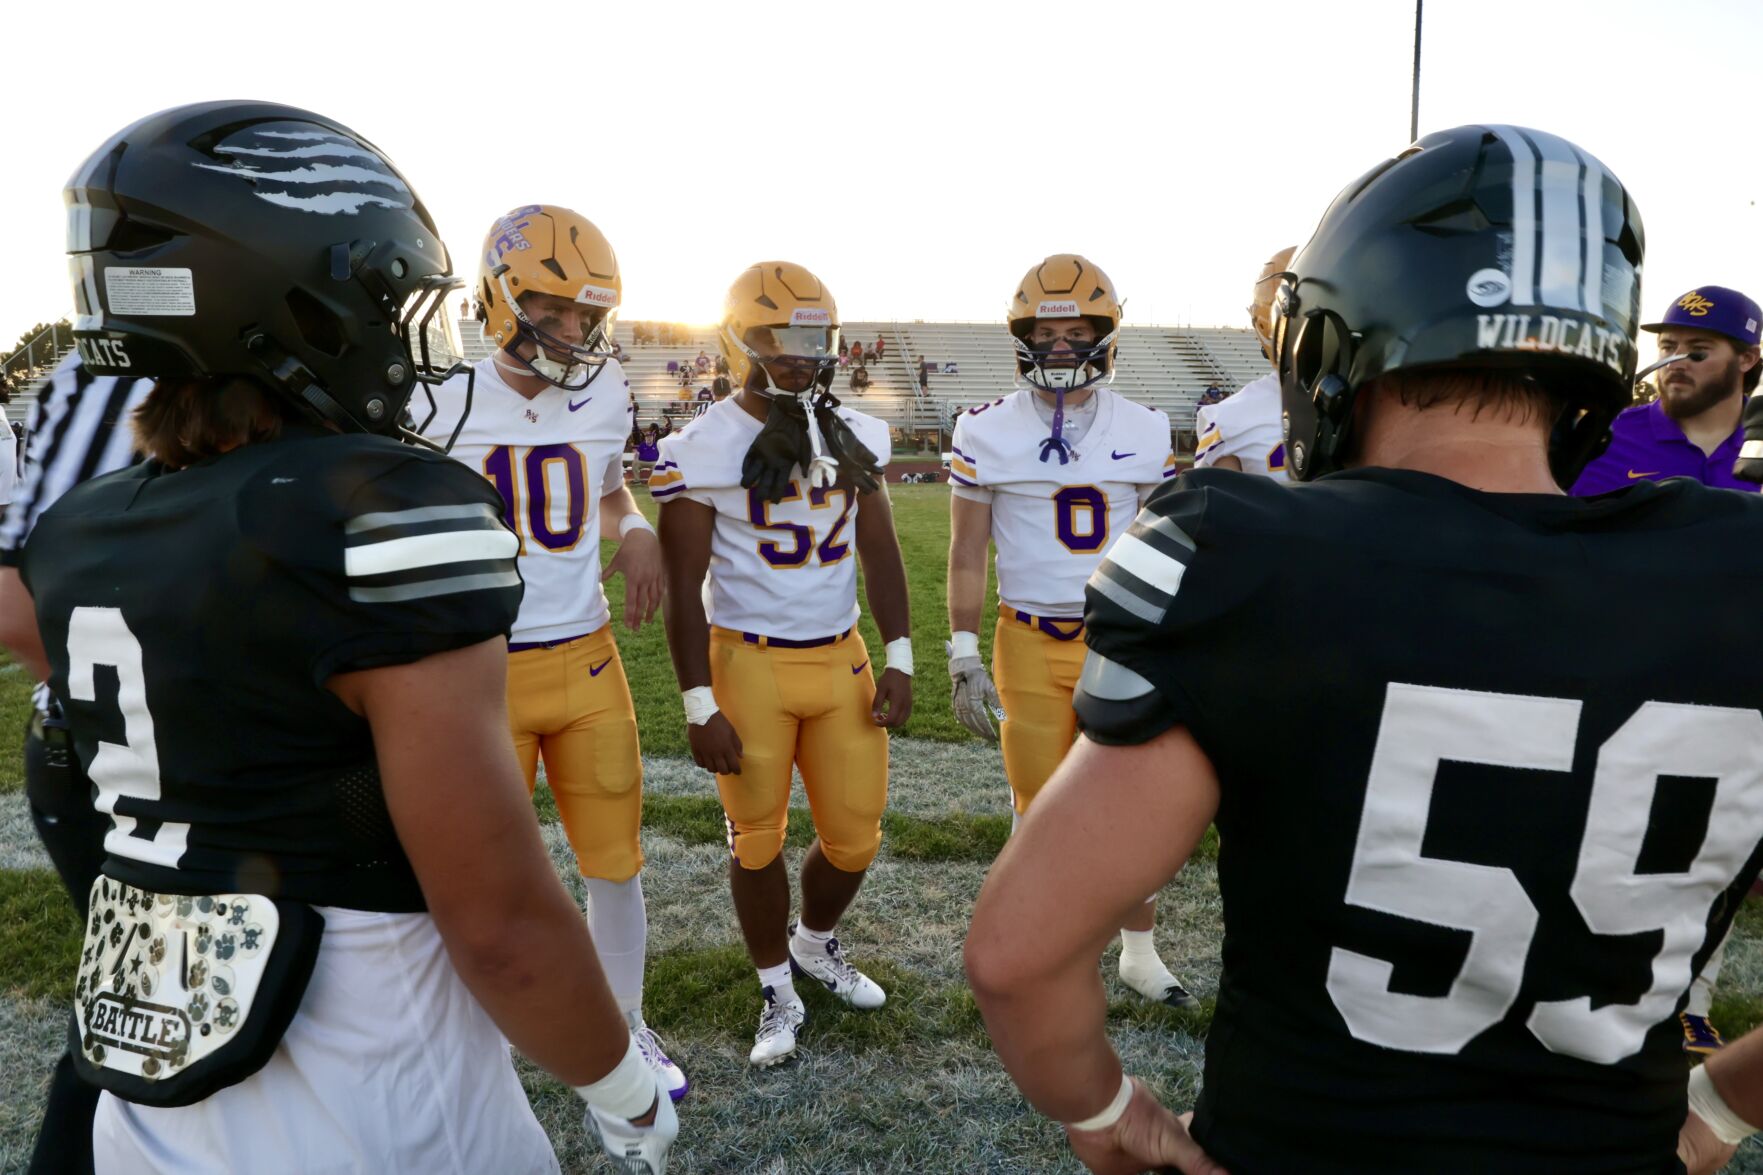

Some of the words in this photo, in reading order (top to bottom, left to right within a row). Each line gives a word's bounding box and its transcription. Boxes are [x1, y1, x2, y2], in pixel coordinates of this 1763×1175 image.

[585, 290, 616, 304] Riddell
[795, 312, 829, 321] Riddell
[1040, 304, 1075, 313] Riddell
[1477, 314, 1623, 375] WILDCATS
[483, 443, 588, 556] 10
[747, 479, 852, 570] 52
[1051, 484, 1110, 554] 0
[67, 606, 191, 869] 2
[1326, 682, 1763, 1064] 59
[92, 1002, 180, 1050] BATTLE
